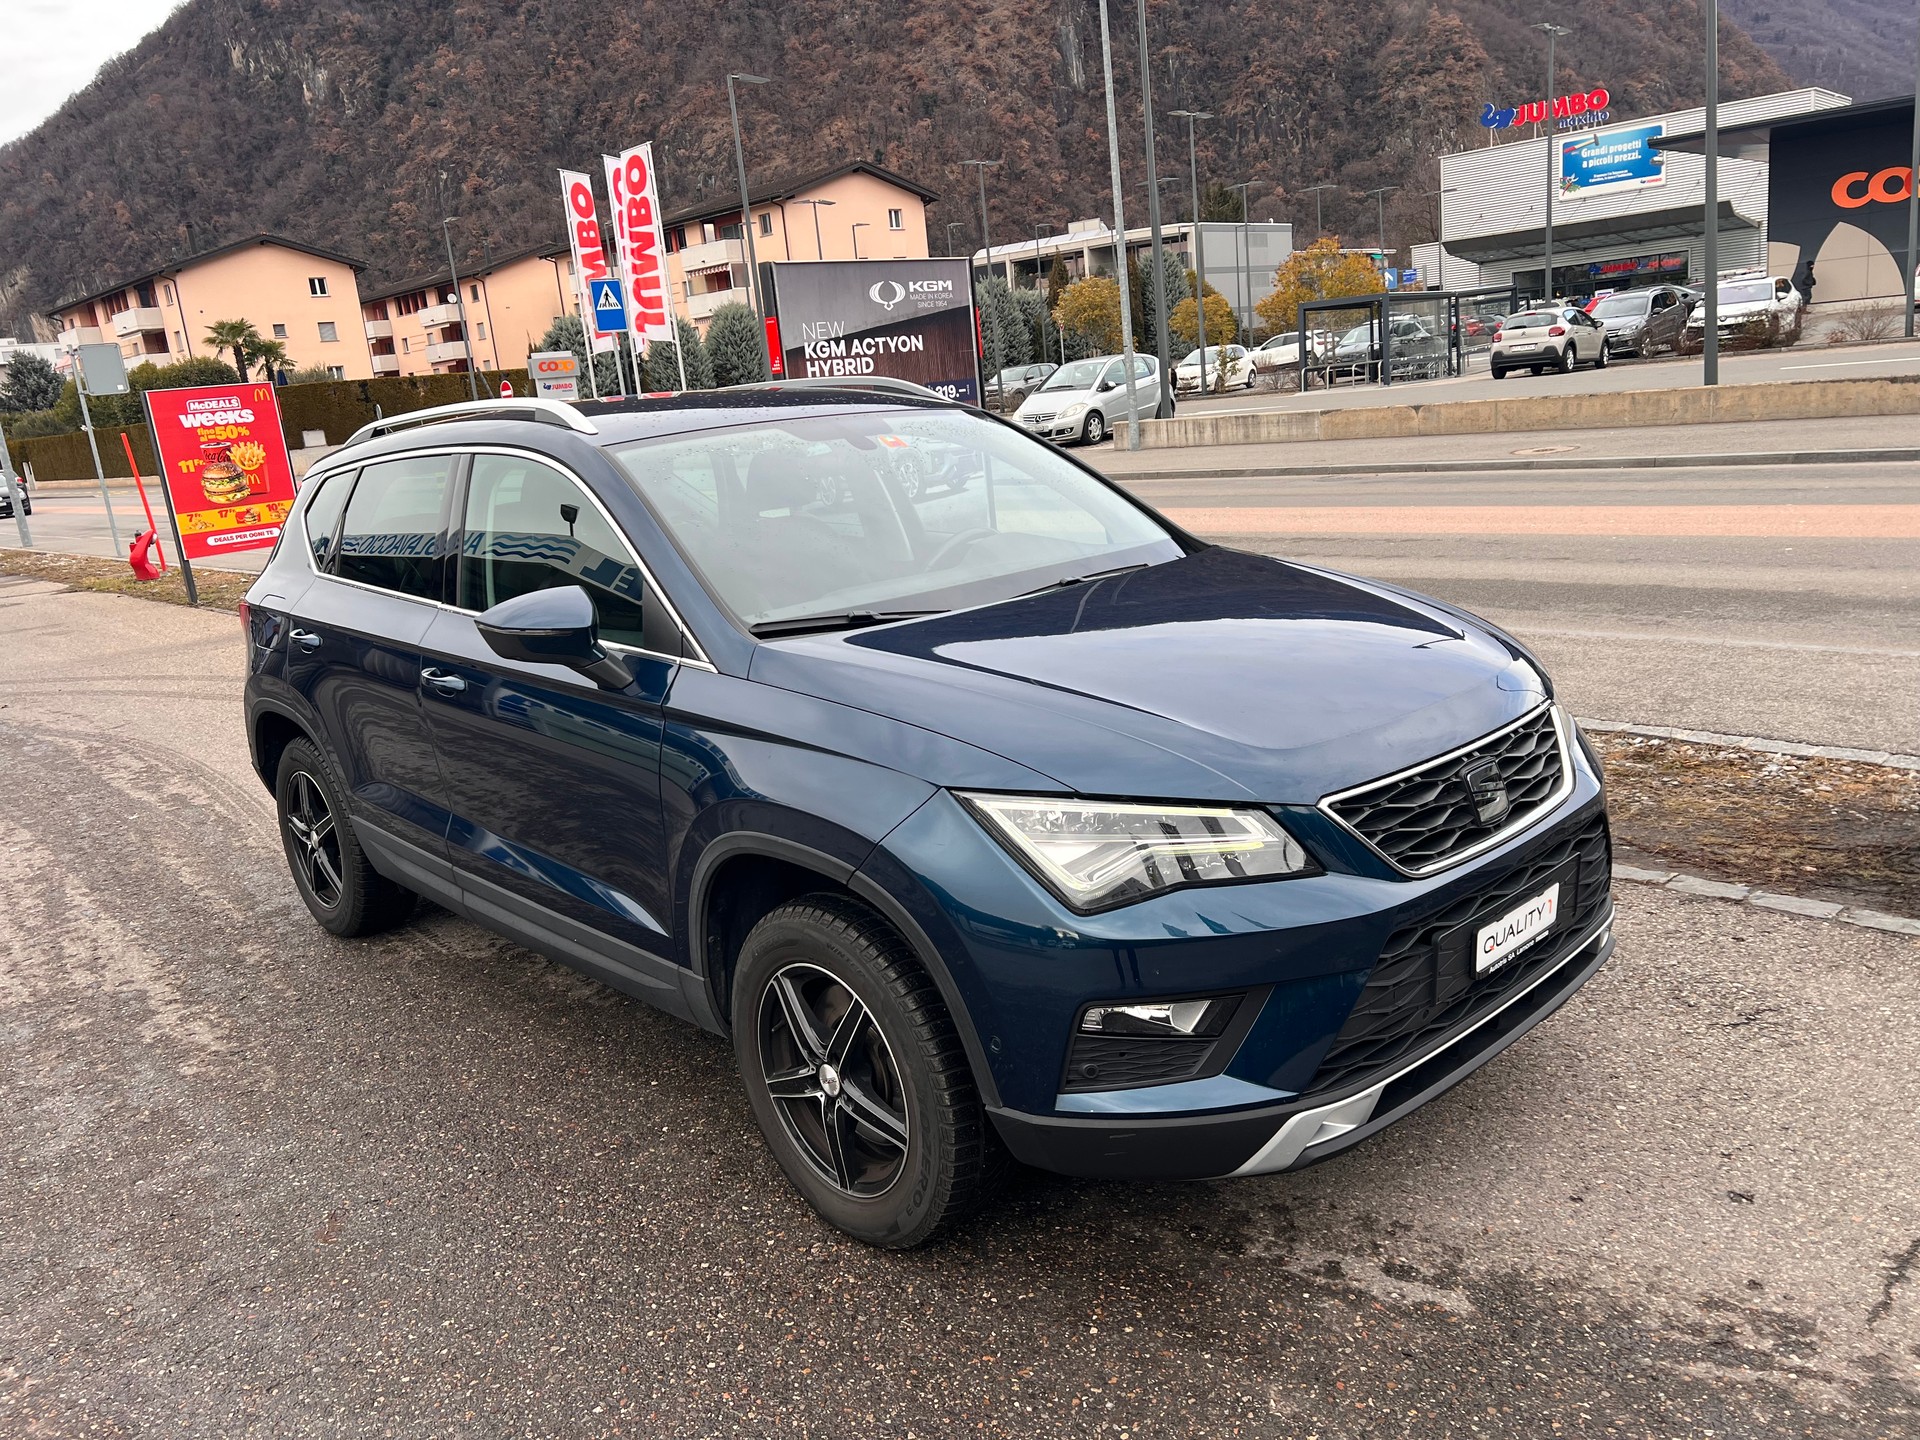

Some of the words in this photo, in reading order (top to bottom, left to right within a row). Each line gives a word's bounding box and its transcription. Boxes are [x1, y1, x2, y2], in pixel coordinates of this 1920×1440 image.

[1513, 88, 1610, 127] JUMBO
[1581, 144, 1608, 158] Grandi
[1609, 139, 1642, 154] progetti
[1588, 155, 1613, 168] piccoli
[1614, 150, 1642, 163] prezzi.
[1831, 166, 1912, 209] co
[625, 154, 666, 334] JUMBO
[908, 280, 953, 292] KGM
[802, 321, 844, 341] NEW
[804, 340, 847, 359] KGM
[850, 335, 924, 356] ACTYON
[538, 360, 576, 374] coop
[806, 357, 875, 378] HYBRID
[190, 398, 240, 411] McDEALS
[214, 535, 235, 543] DEALS
